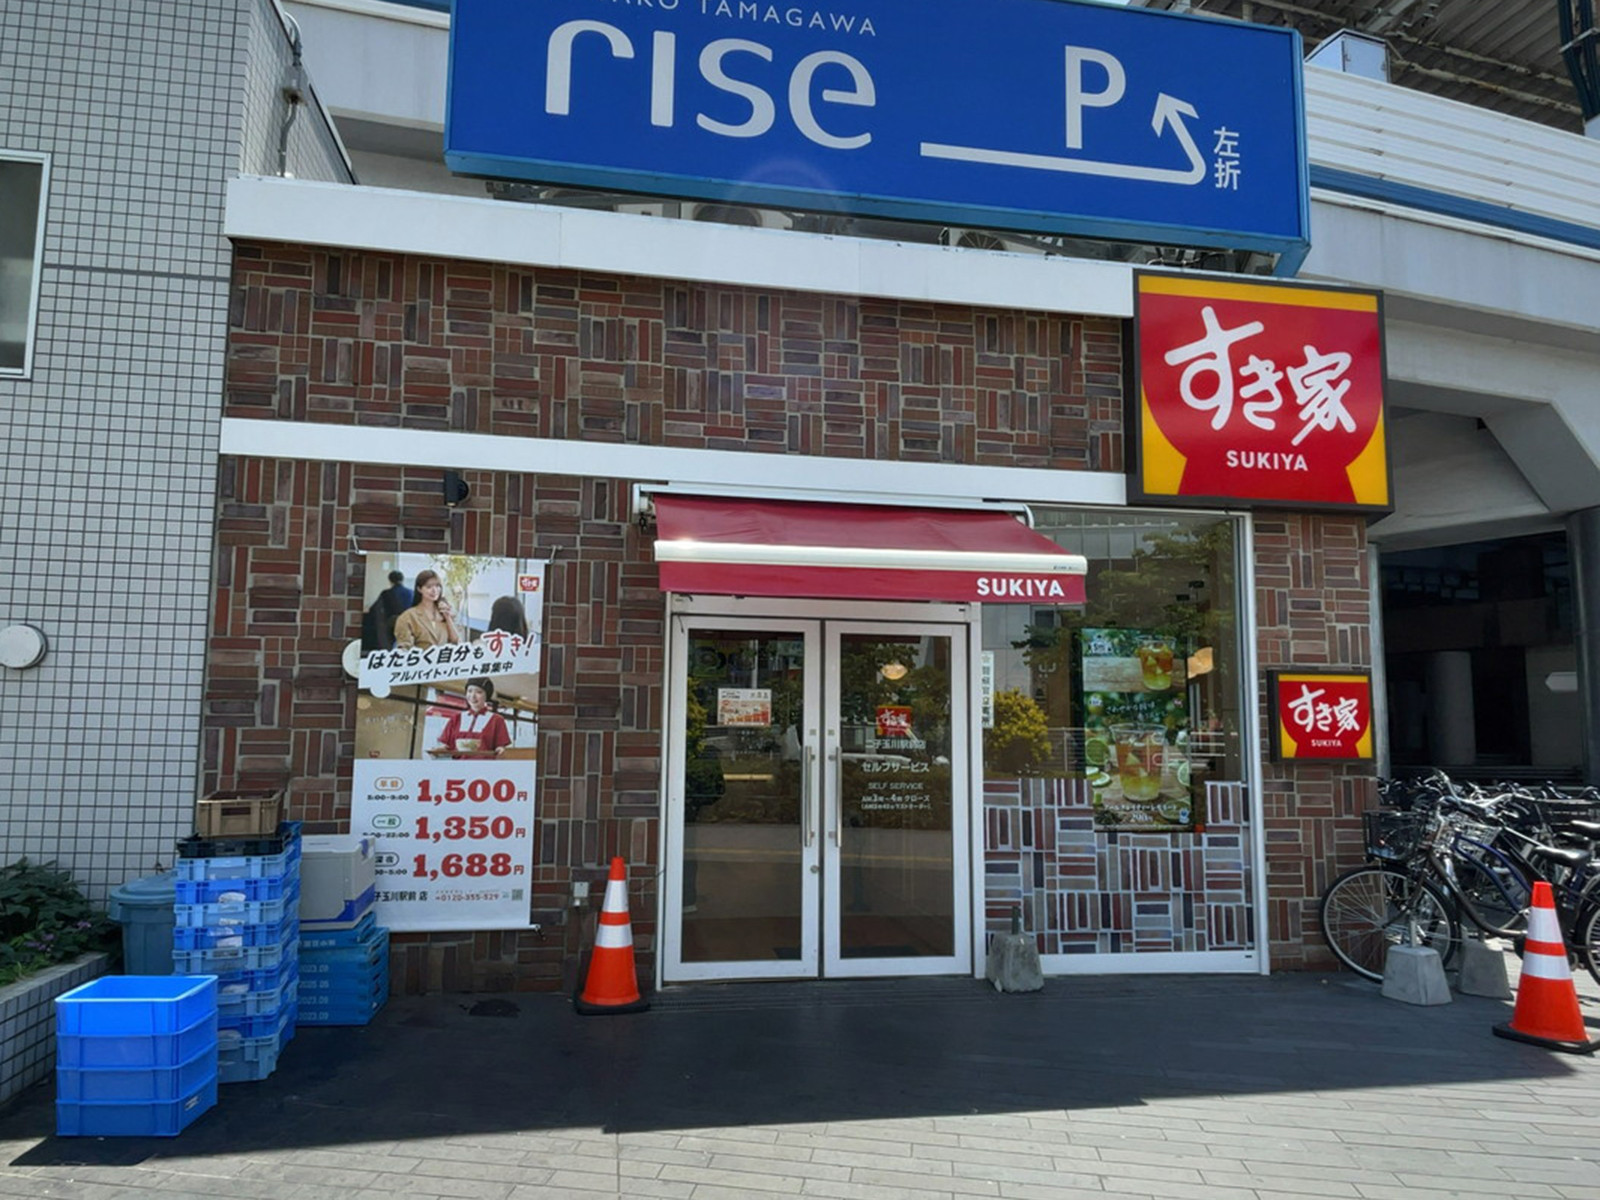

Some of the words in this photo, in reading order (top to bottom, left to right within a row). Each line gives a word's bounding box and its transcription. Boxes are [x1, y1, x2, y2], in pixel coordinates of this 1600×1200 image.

[702, 0, 876, 36] TAMAGAWA
[546, 20, 877, 150] rise
[1065, 45, 1127, 149] P
[1213, 126, 1242, 191] 左折
[1164, 306, 1357, 446] すき家
[1226, 450, 1309, 471] SUKIYA
[976, 577, 1065, 596] SUKIYA
[1288, 684, 1360, 737] すき家
[1311, 739, 1342, 747] SUKIYA
[862, 761, 930, 773] セルフサービス
[889, 782, 924, 790] SERVICE
